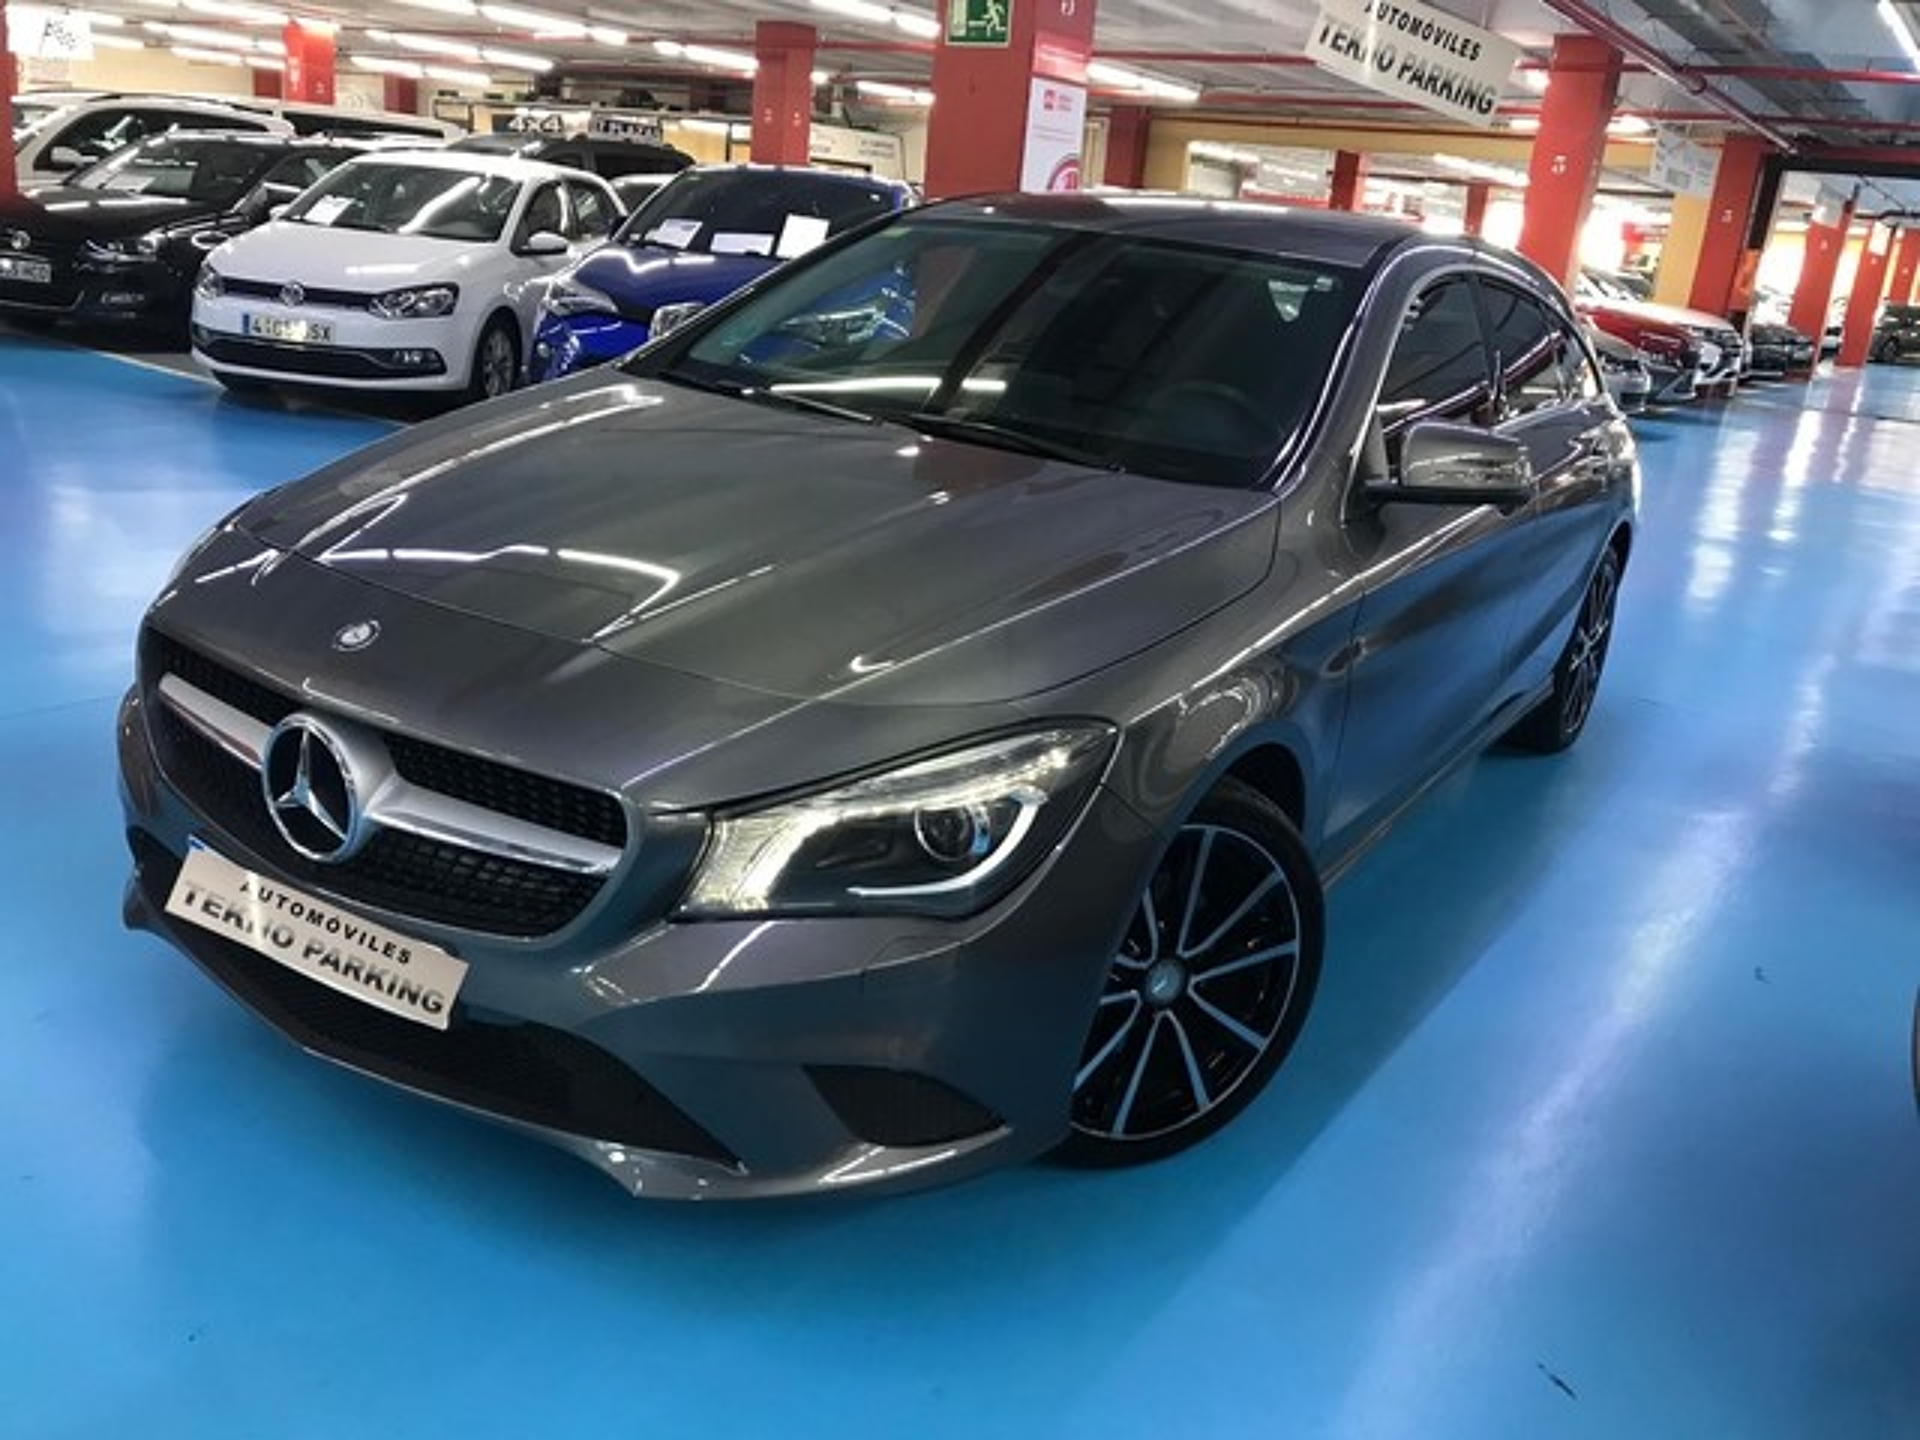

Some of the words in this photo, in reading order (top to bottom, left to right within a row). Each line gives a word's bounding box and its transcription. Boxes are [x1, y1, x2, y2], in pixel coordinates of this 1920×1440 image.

[1396, 48, 1497, 116] PARKING
[238, 879, 413, 965] AUTOMÓVILES
[302, 936, 445, 1015] PARKING
